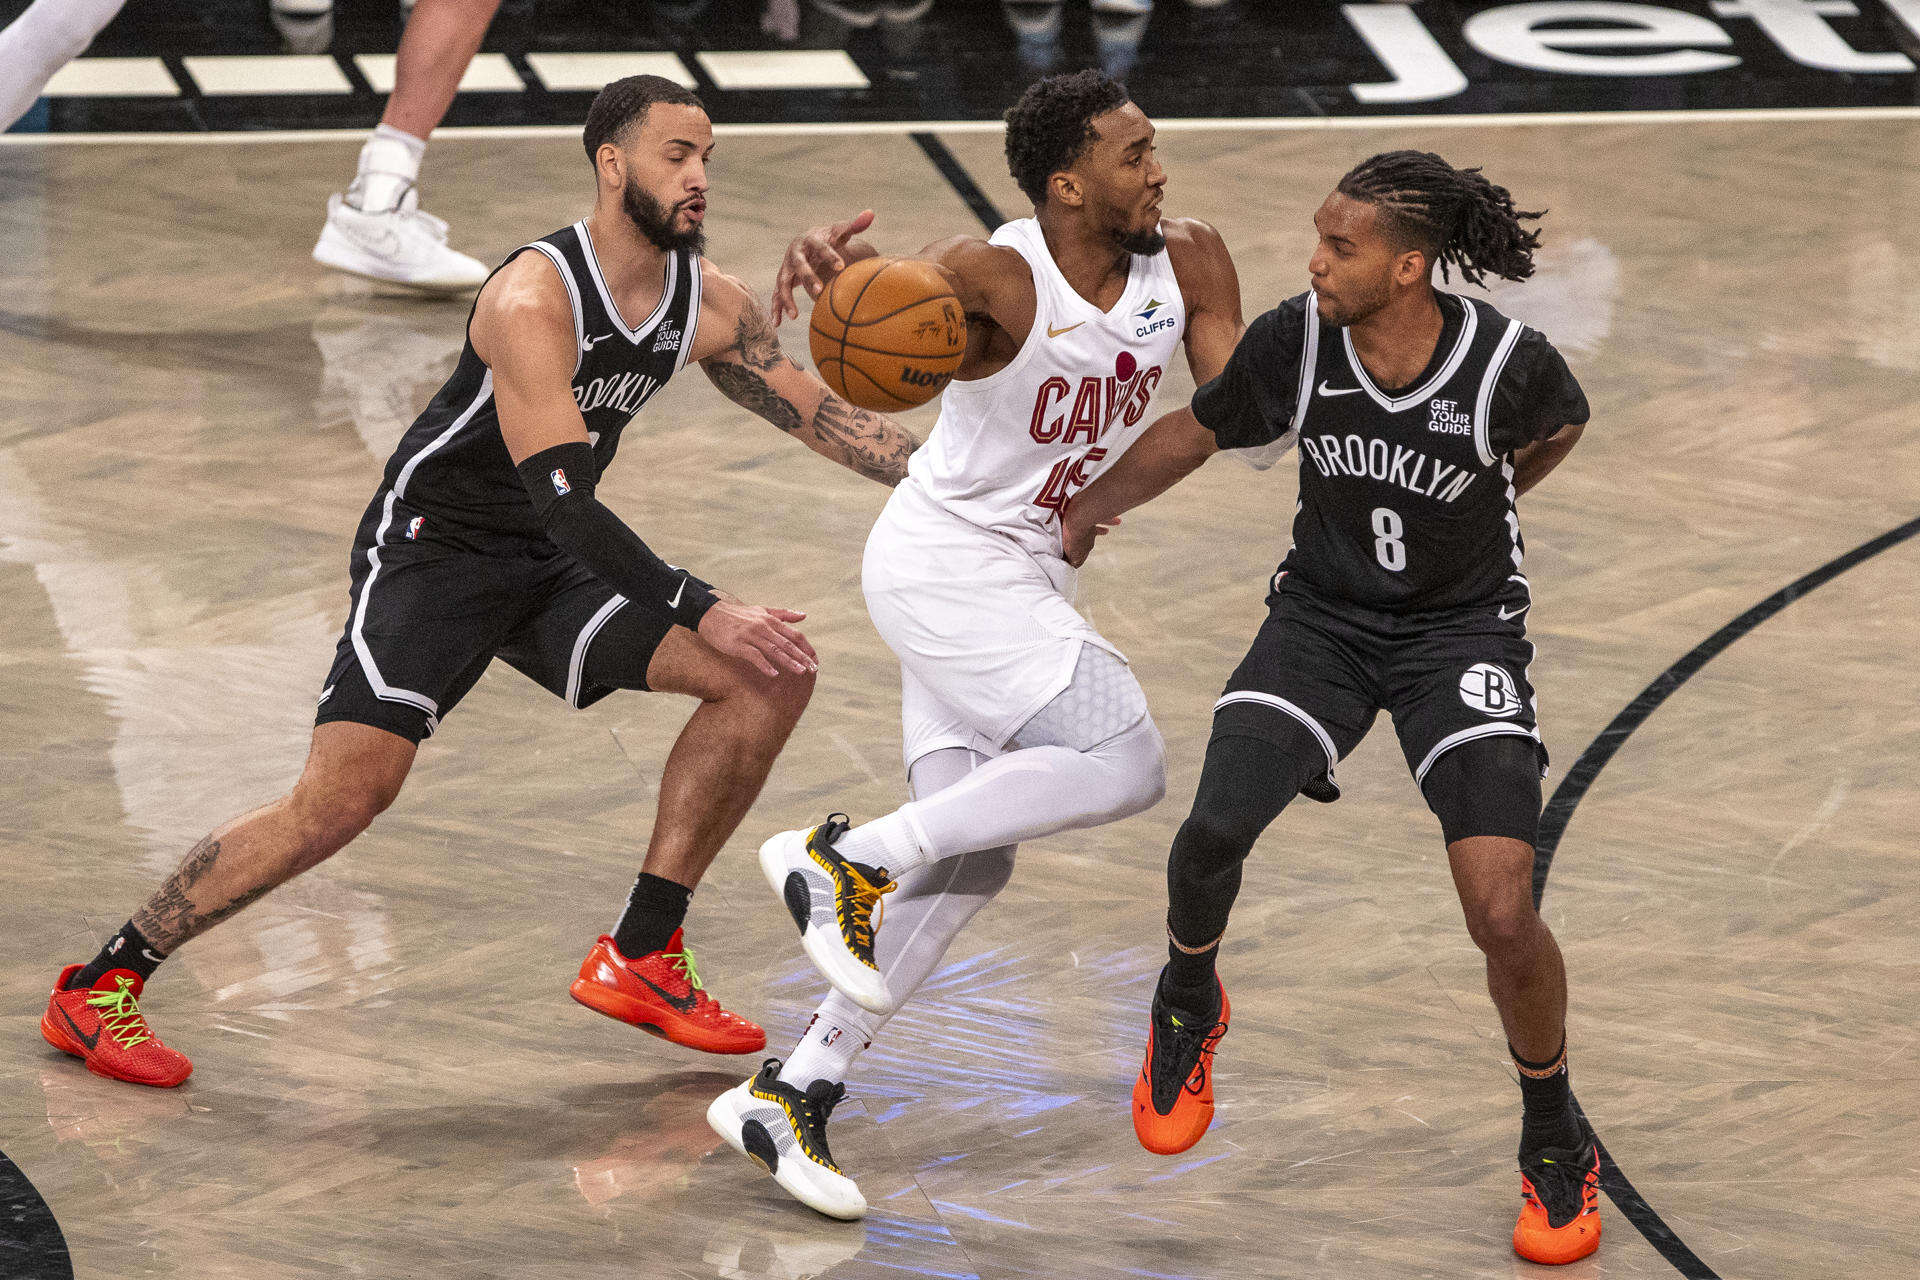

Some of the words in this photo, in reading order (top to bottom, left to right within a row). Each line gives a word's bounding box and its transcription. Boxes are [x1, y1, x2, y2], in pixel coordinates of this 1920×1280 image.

[1340, 0, 1920, 103] jet
[656, 330, 680, 342] YOUR
[1136, 317, 1175, 338] CLIFFS
[652, 341, 680, 352] GUIDE
[1029, 365, 1162, 444] CAVS
[1430, 399, 1458, 411] GET
[1430, 409, 1470, 425] YOUR
[1428, 420, 1471, 436] GUIDE
[1303, 434, 1477, 503] BROOKLYN
[1371, 507, 1407, 572] 8
[1484, 669, 1506, 710] B
